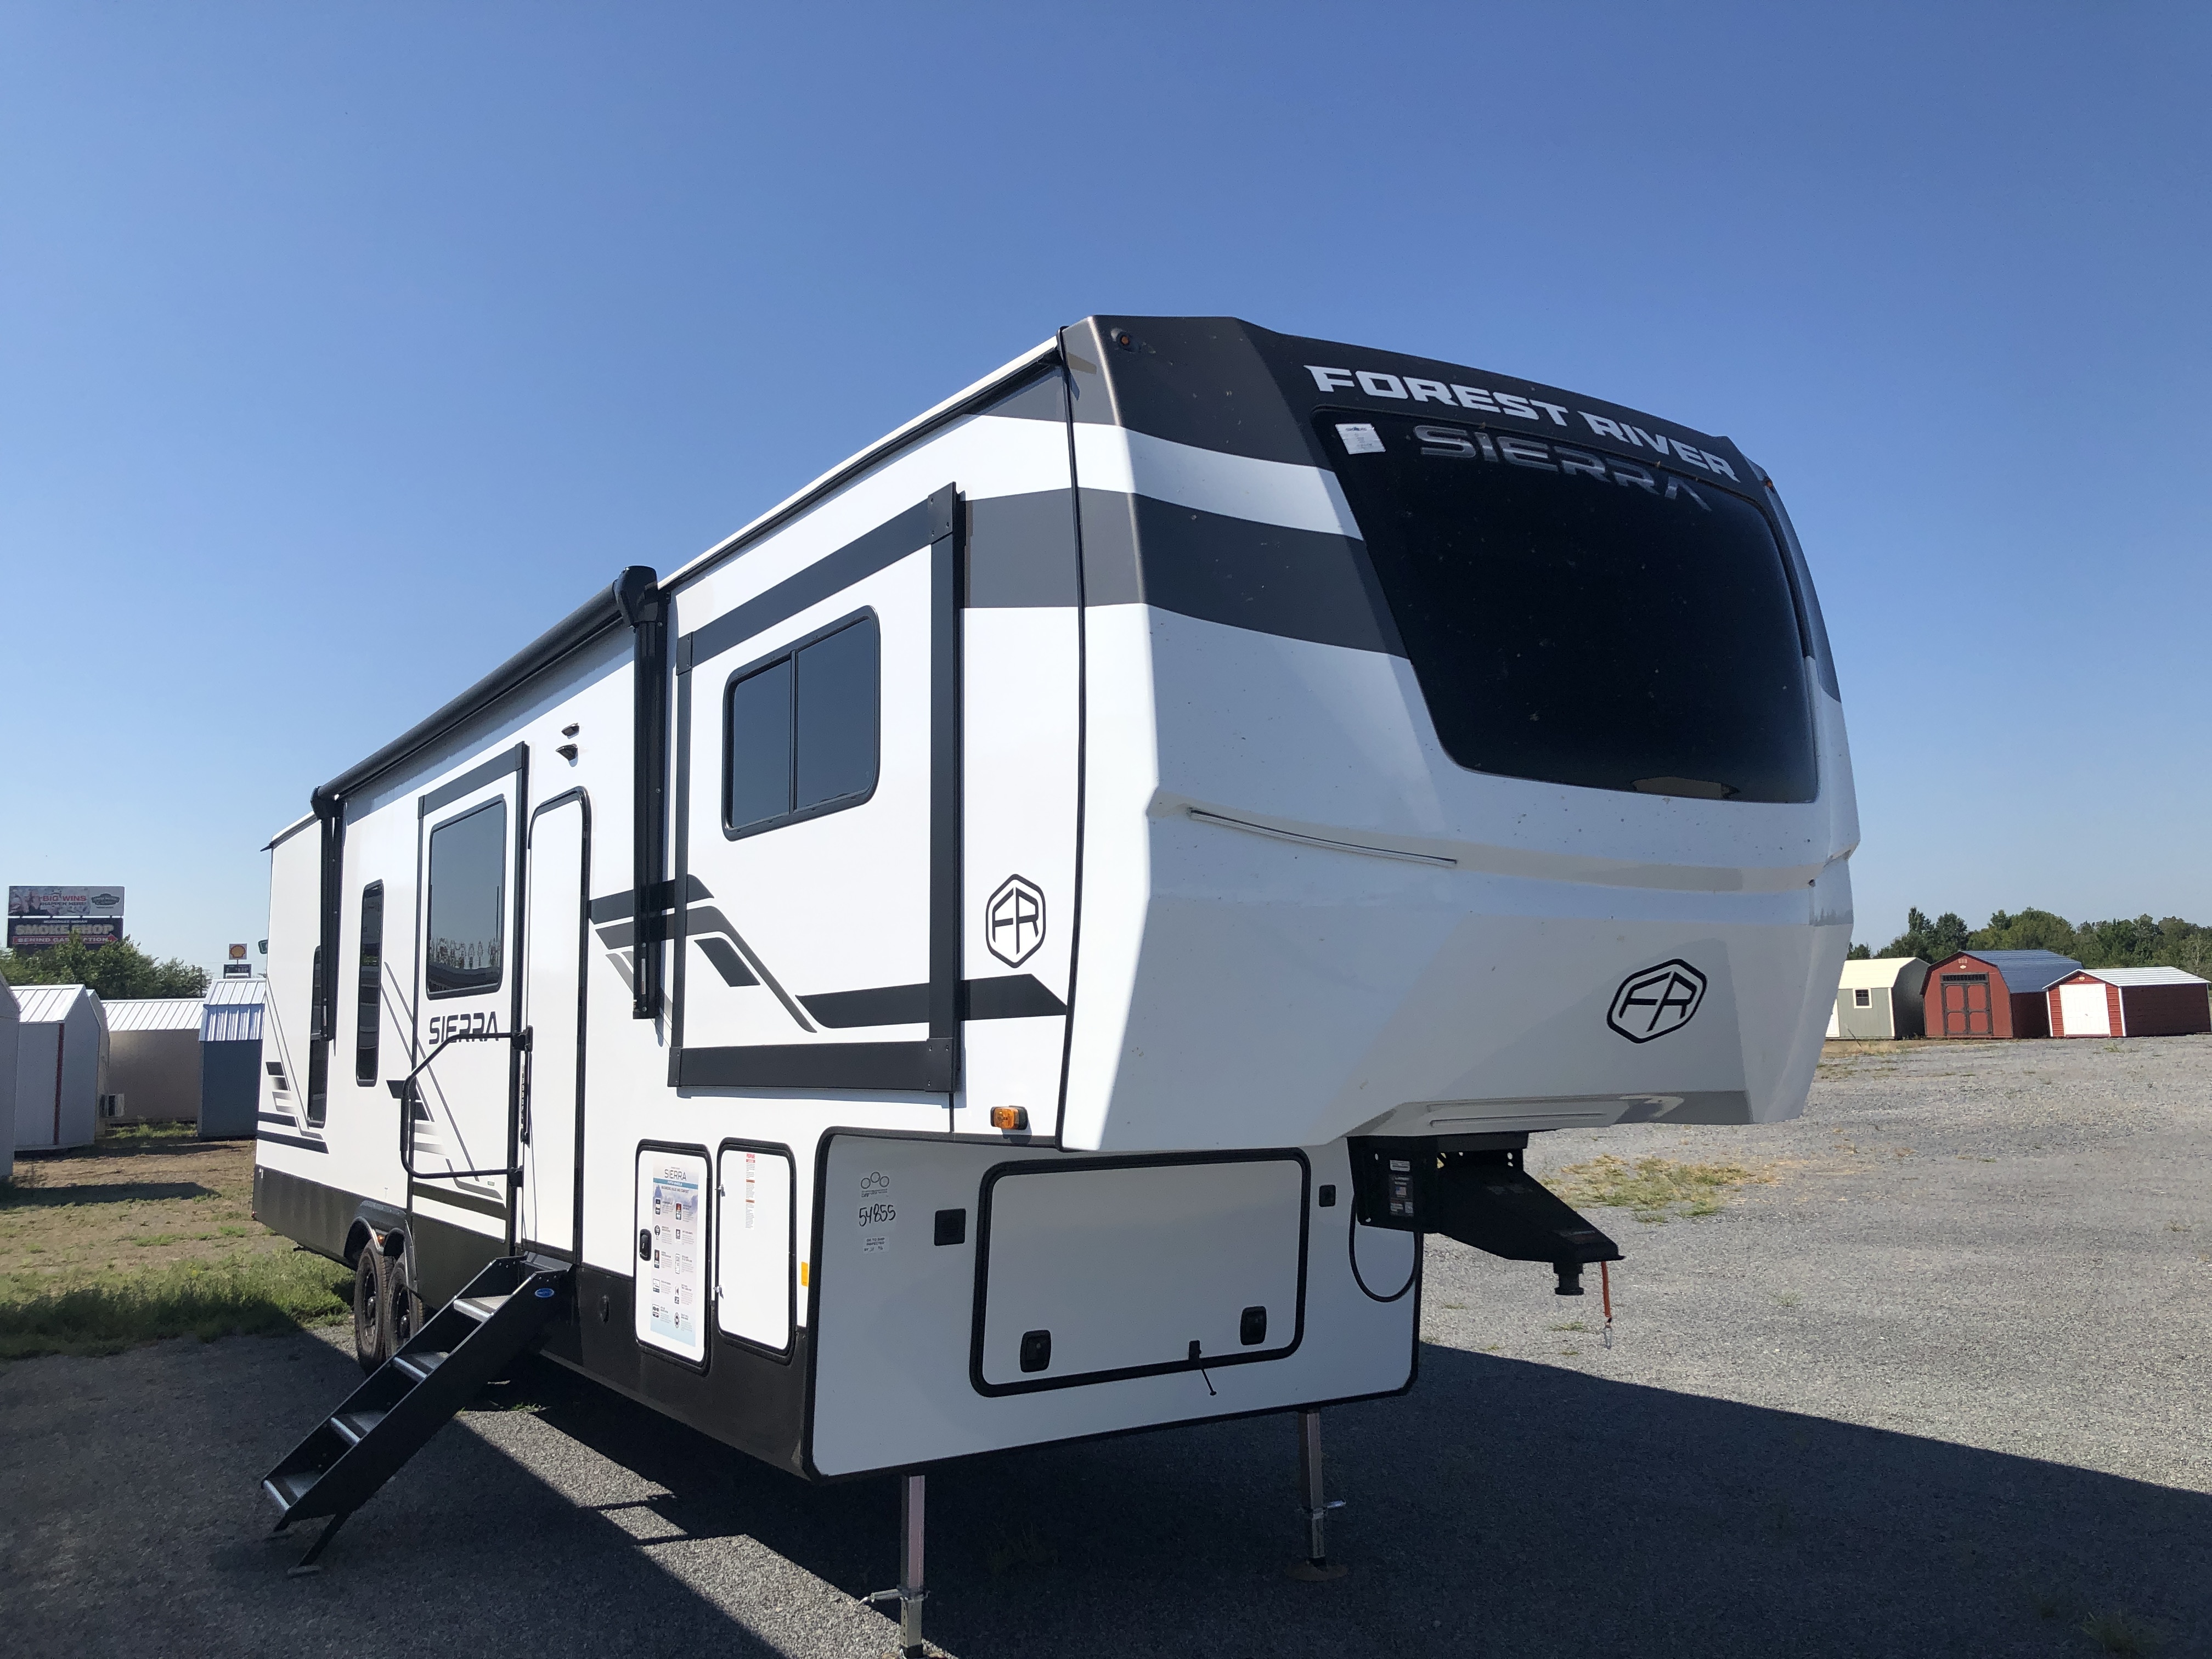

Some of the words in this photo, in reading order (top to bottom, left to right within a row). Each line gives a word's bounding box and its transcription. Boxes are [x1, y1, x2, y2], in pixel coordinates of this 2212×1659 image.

[1304, 365, 1568, 427] FOREST
[1577, 410, 1741, 483] RIVER
[1414, 425, 1712, 512] SIERRA
[15, 924, 70, 935] SMOKE
[428, 1011, 499, 1045] SIERRA
[664, 1169, 687, 1181] SIERRA
[859, 1203, 896, 1227] 54855
